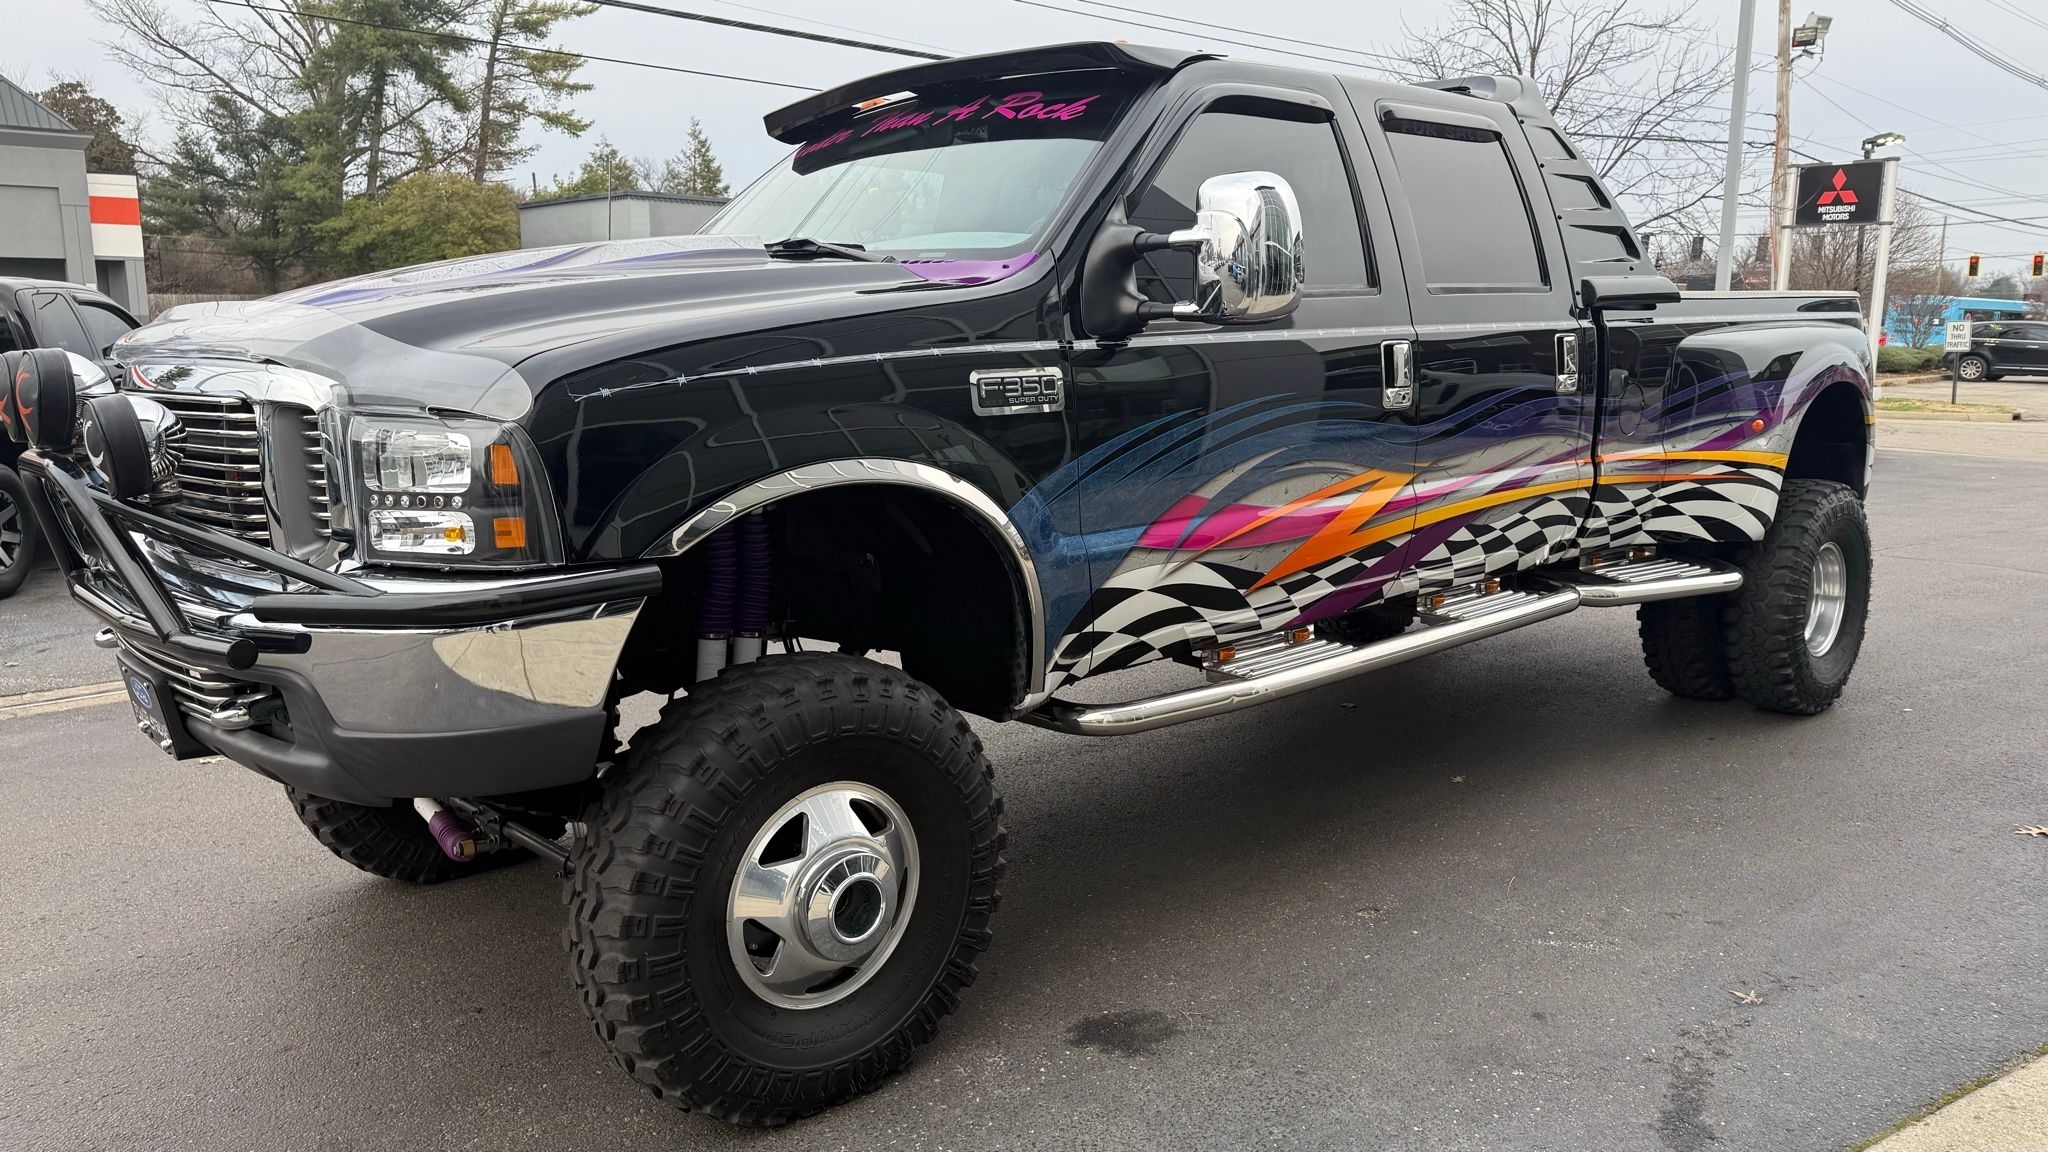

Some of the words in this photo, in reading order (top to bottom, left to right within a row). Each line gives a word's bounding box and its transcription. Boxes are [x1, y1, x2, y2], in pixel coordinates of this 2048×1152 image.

[931, 94, 991, 126] A
[980, 91, 1101, 121] Rock
[1817, 205, 1856, 213] MITSUBISHI
[1822, 213, 1850, 221] MOTORS
[1952, 324, 1965, 332] NO
